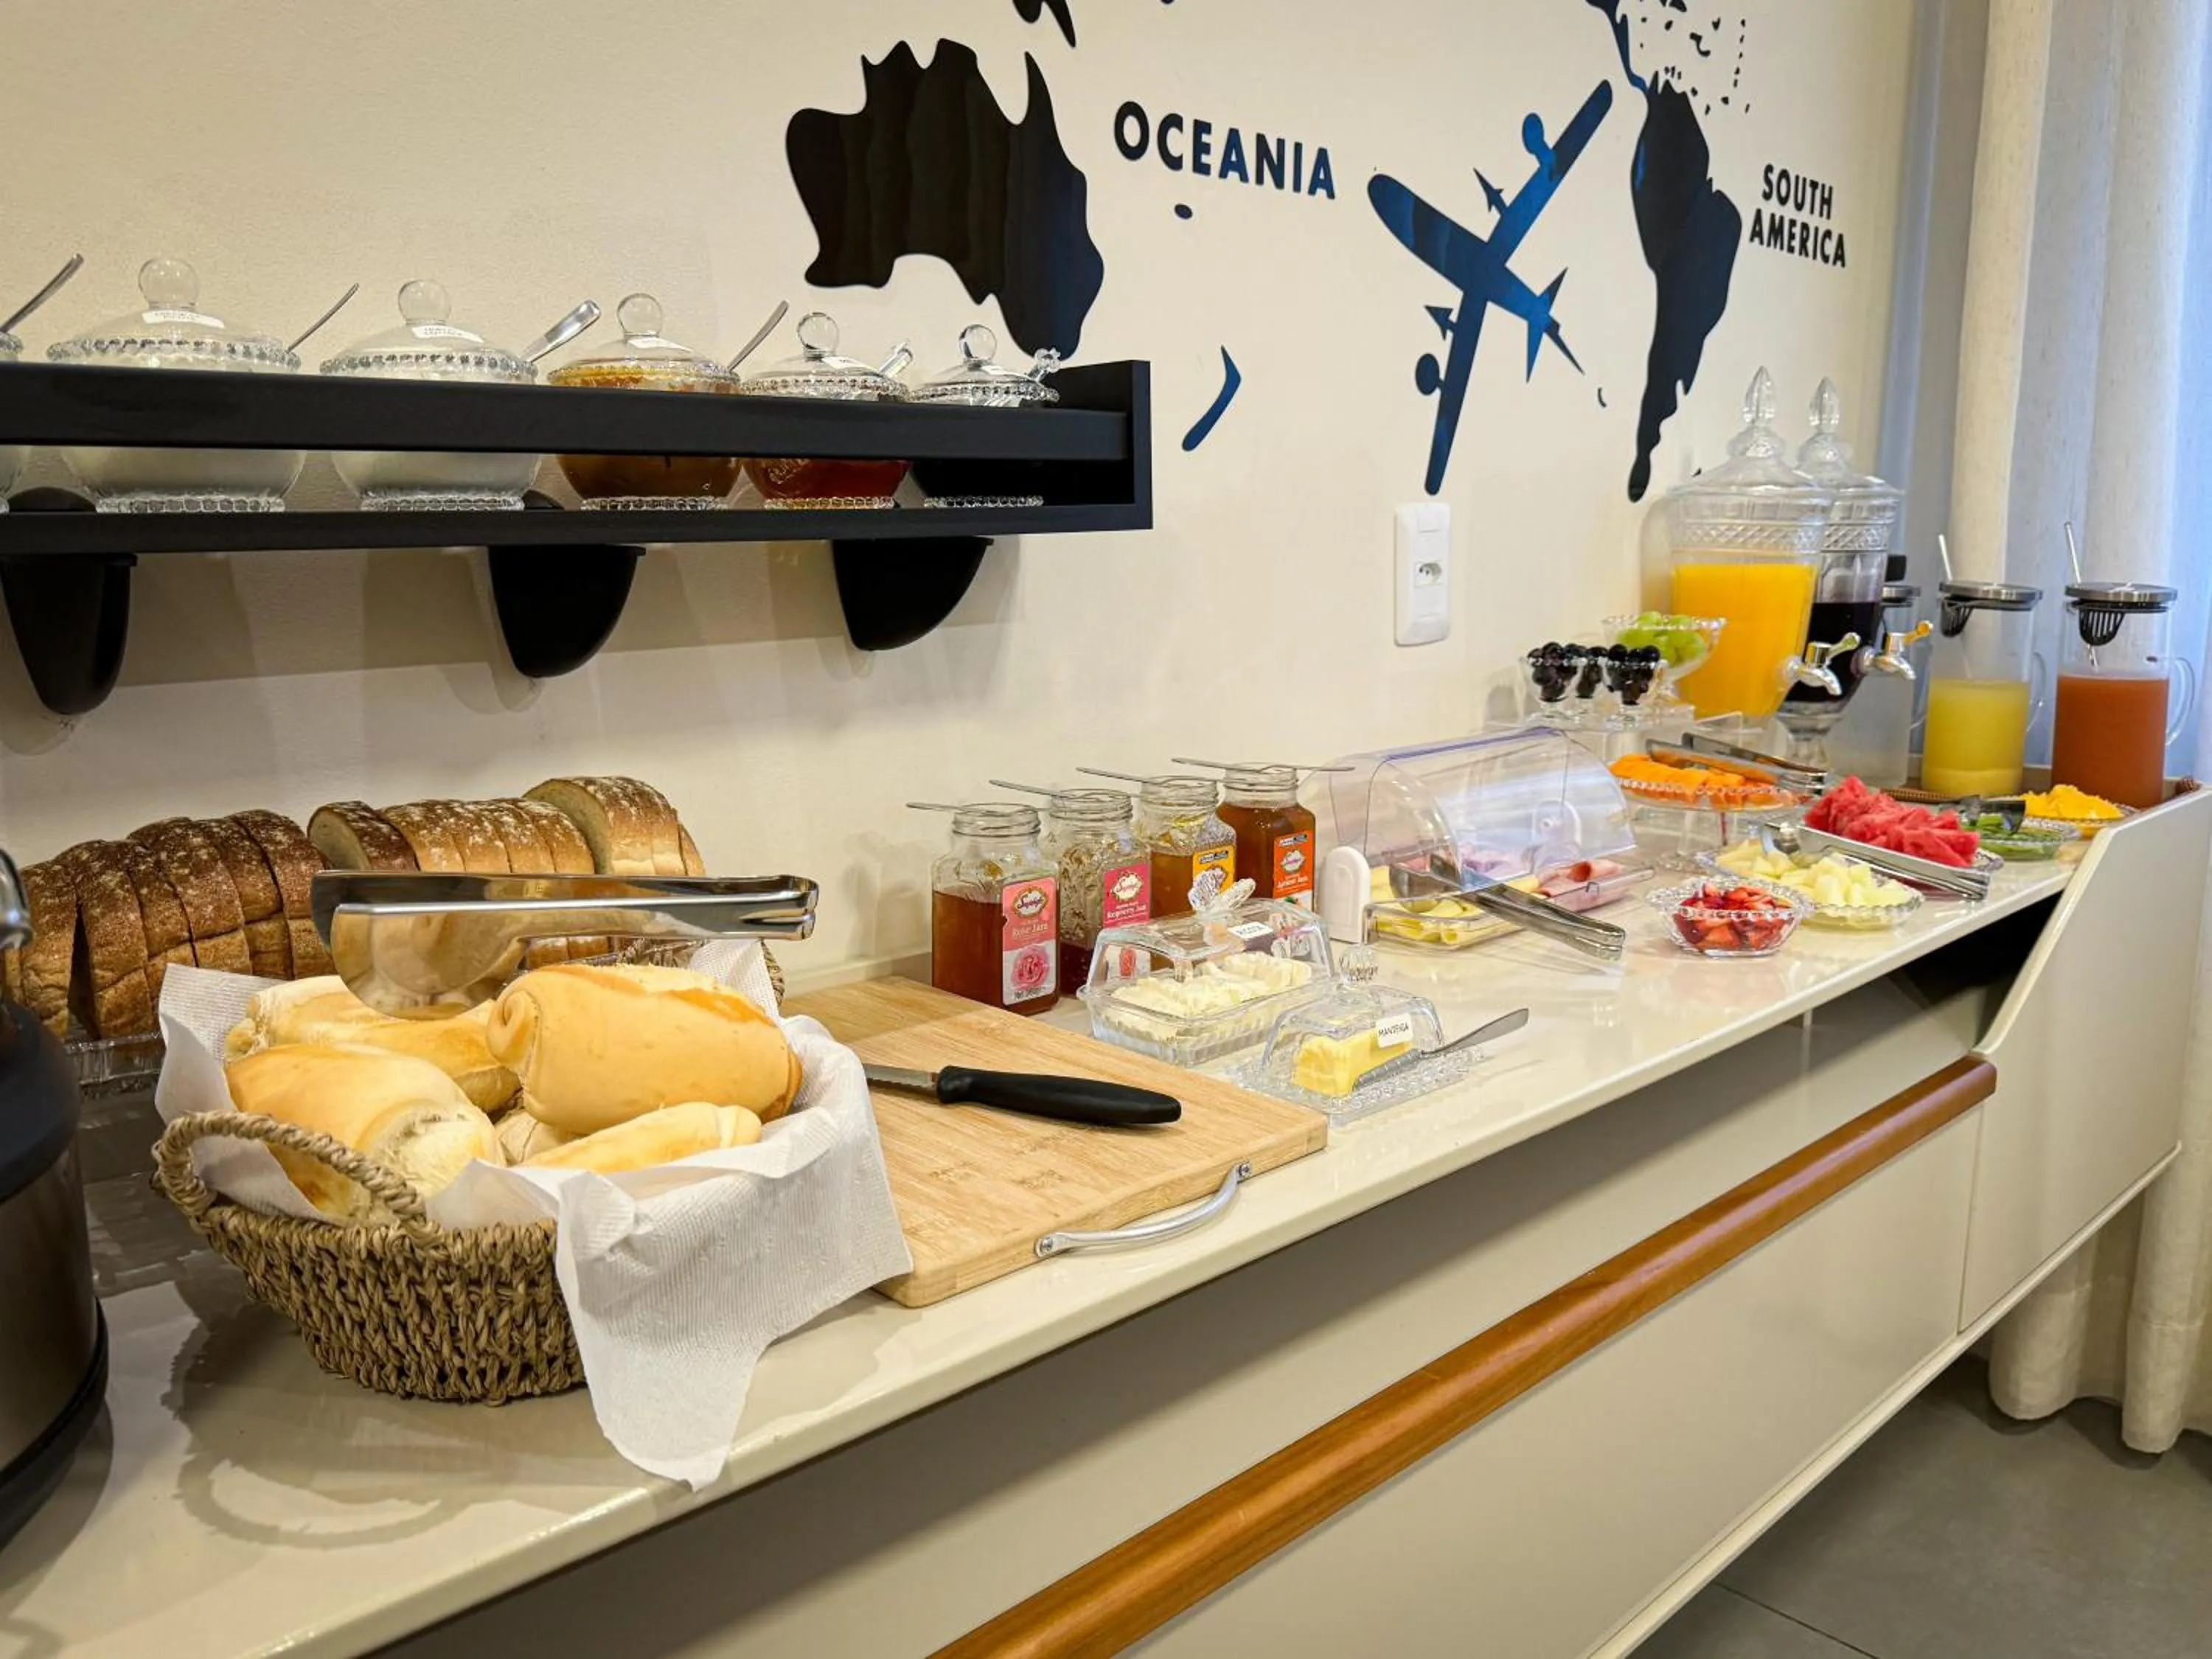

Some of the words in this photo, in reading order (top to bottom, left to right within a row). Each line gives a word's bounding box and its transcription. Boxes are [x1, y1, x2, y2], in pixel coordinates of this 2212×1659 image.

[1114, 100, 1335, 200] OCEANIA
[1761, 162, 1833, 220] SOUTH
[1749, 207, 1846, 268] AMERICA
